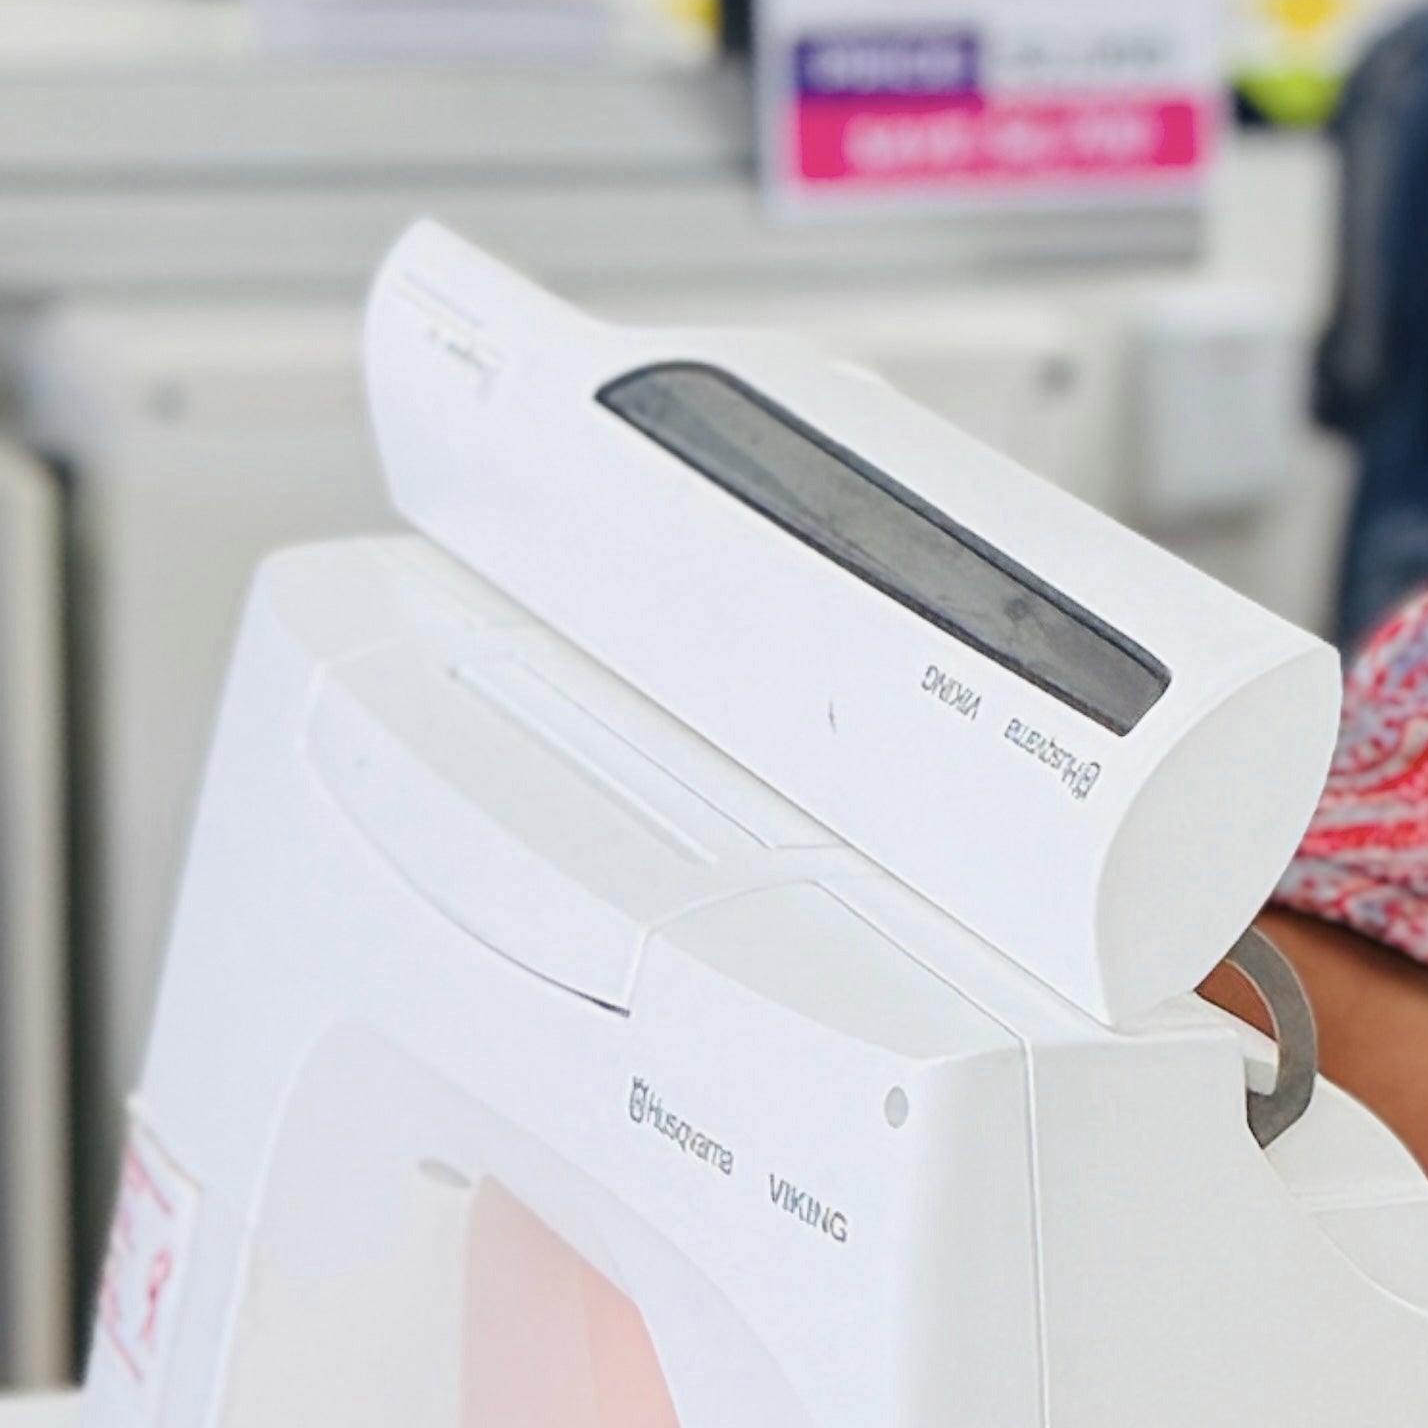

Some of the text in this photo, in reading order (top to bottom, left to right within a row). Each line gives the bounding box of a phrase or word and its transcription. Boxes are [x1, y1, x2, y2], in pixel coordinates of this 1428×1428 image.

[921, 664, 982, 721] VIKING
[647, 1091, 847, 1243] Husqvarna VIKING
